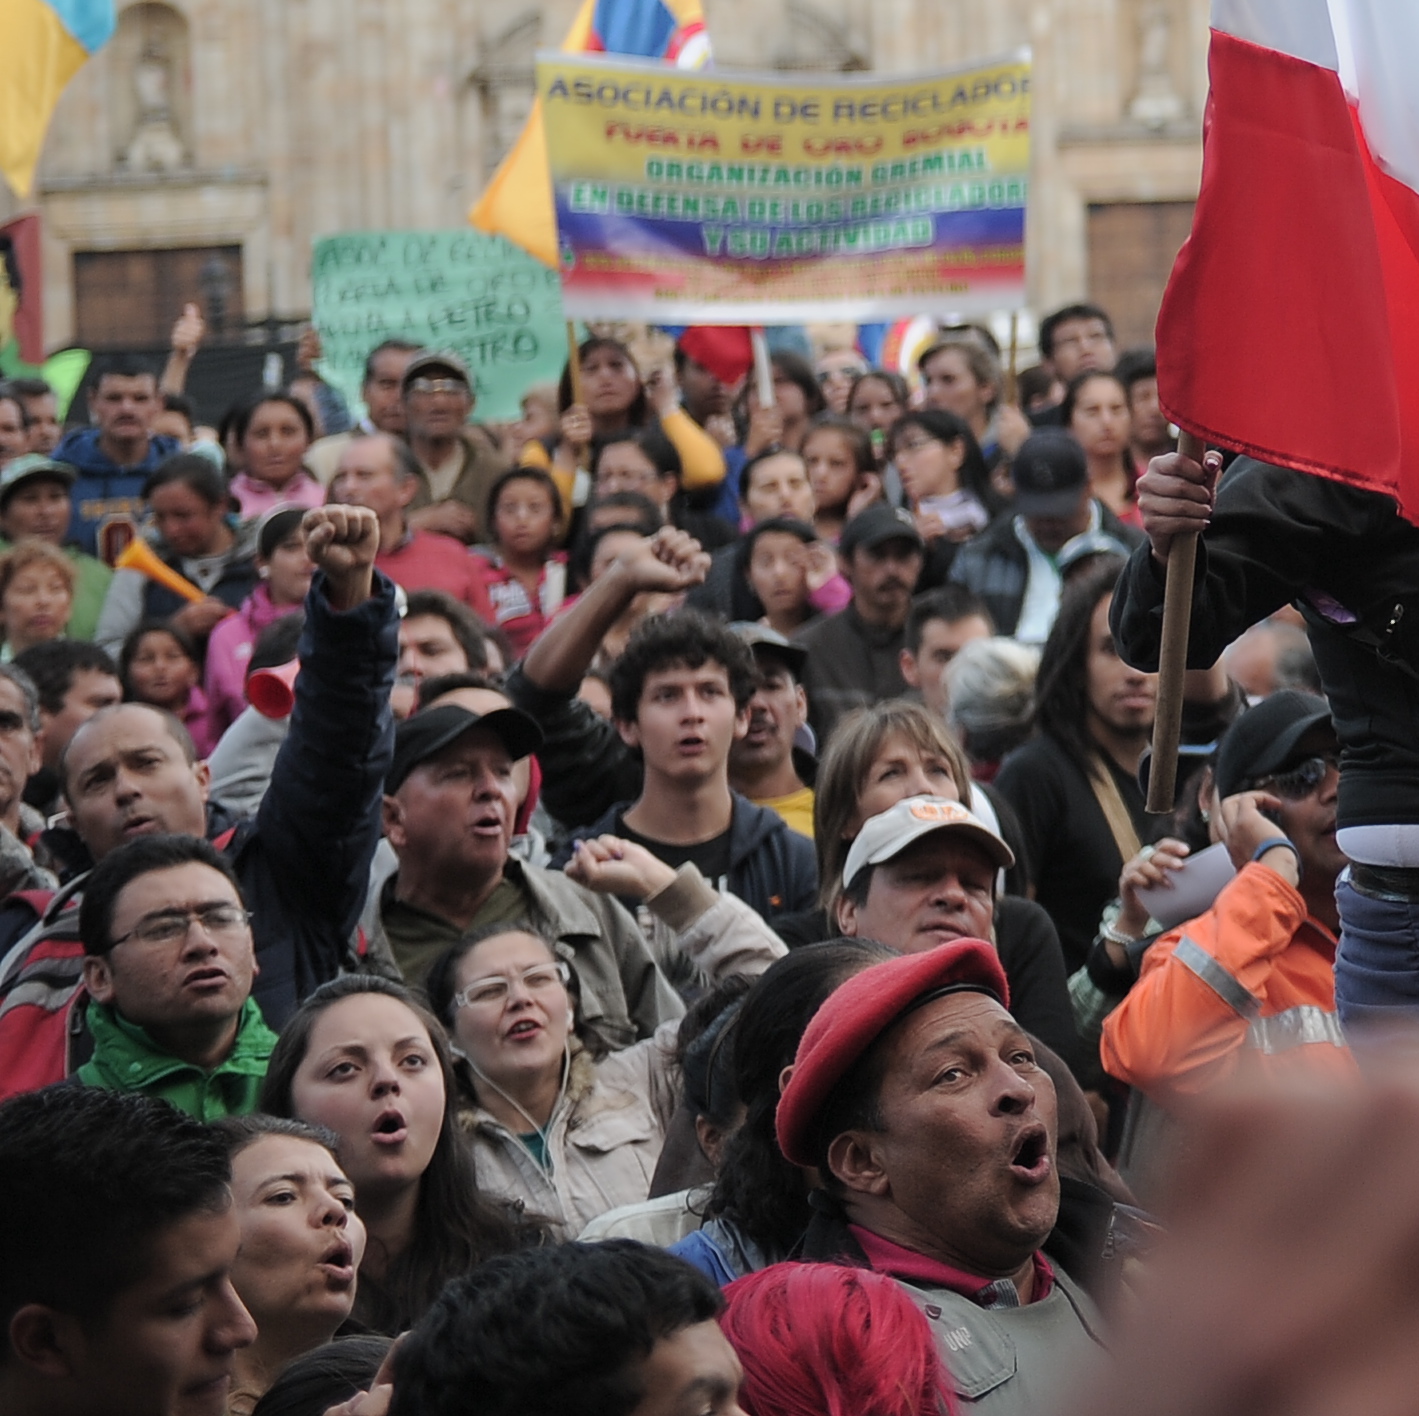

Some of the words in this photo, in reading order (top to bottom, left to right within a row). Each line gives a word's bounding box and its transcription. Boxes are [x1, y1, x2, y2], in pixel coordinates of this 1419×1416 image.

[549, 77, 761, 121] ASOCIACIÓN
[774, 95, 820, 124] DE
[869, 147, 986, 183] GREMIAL
[571, 182, 609, 212] EN
[614, 186, 742, 219] DEFENSA
[746, 197, 785, 222] DE
[789, 198, 844, 223] LOS
[726, 225, 771, 261] SU
[772, 215, 933, 258] ACTIVIDAD
